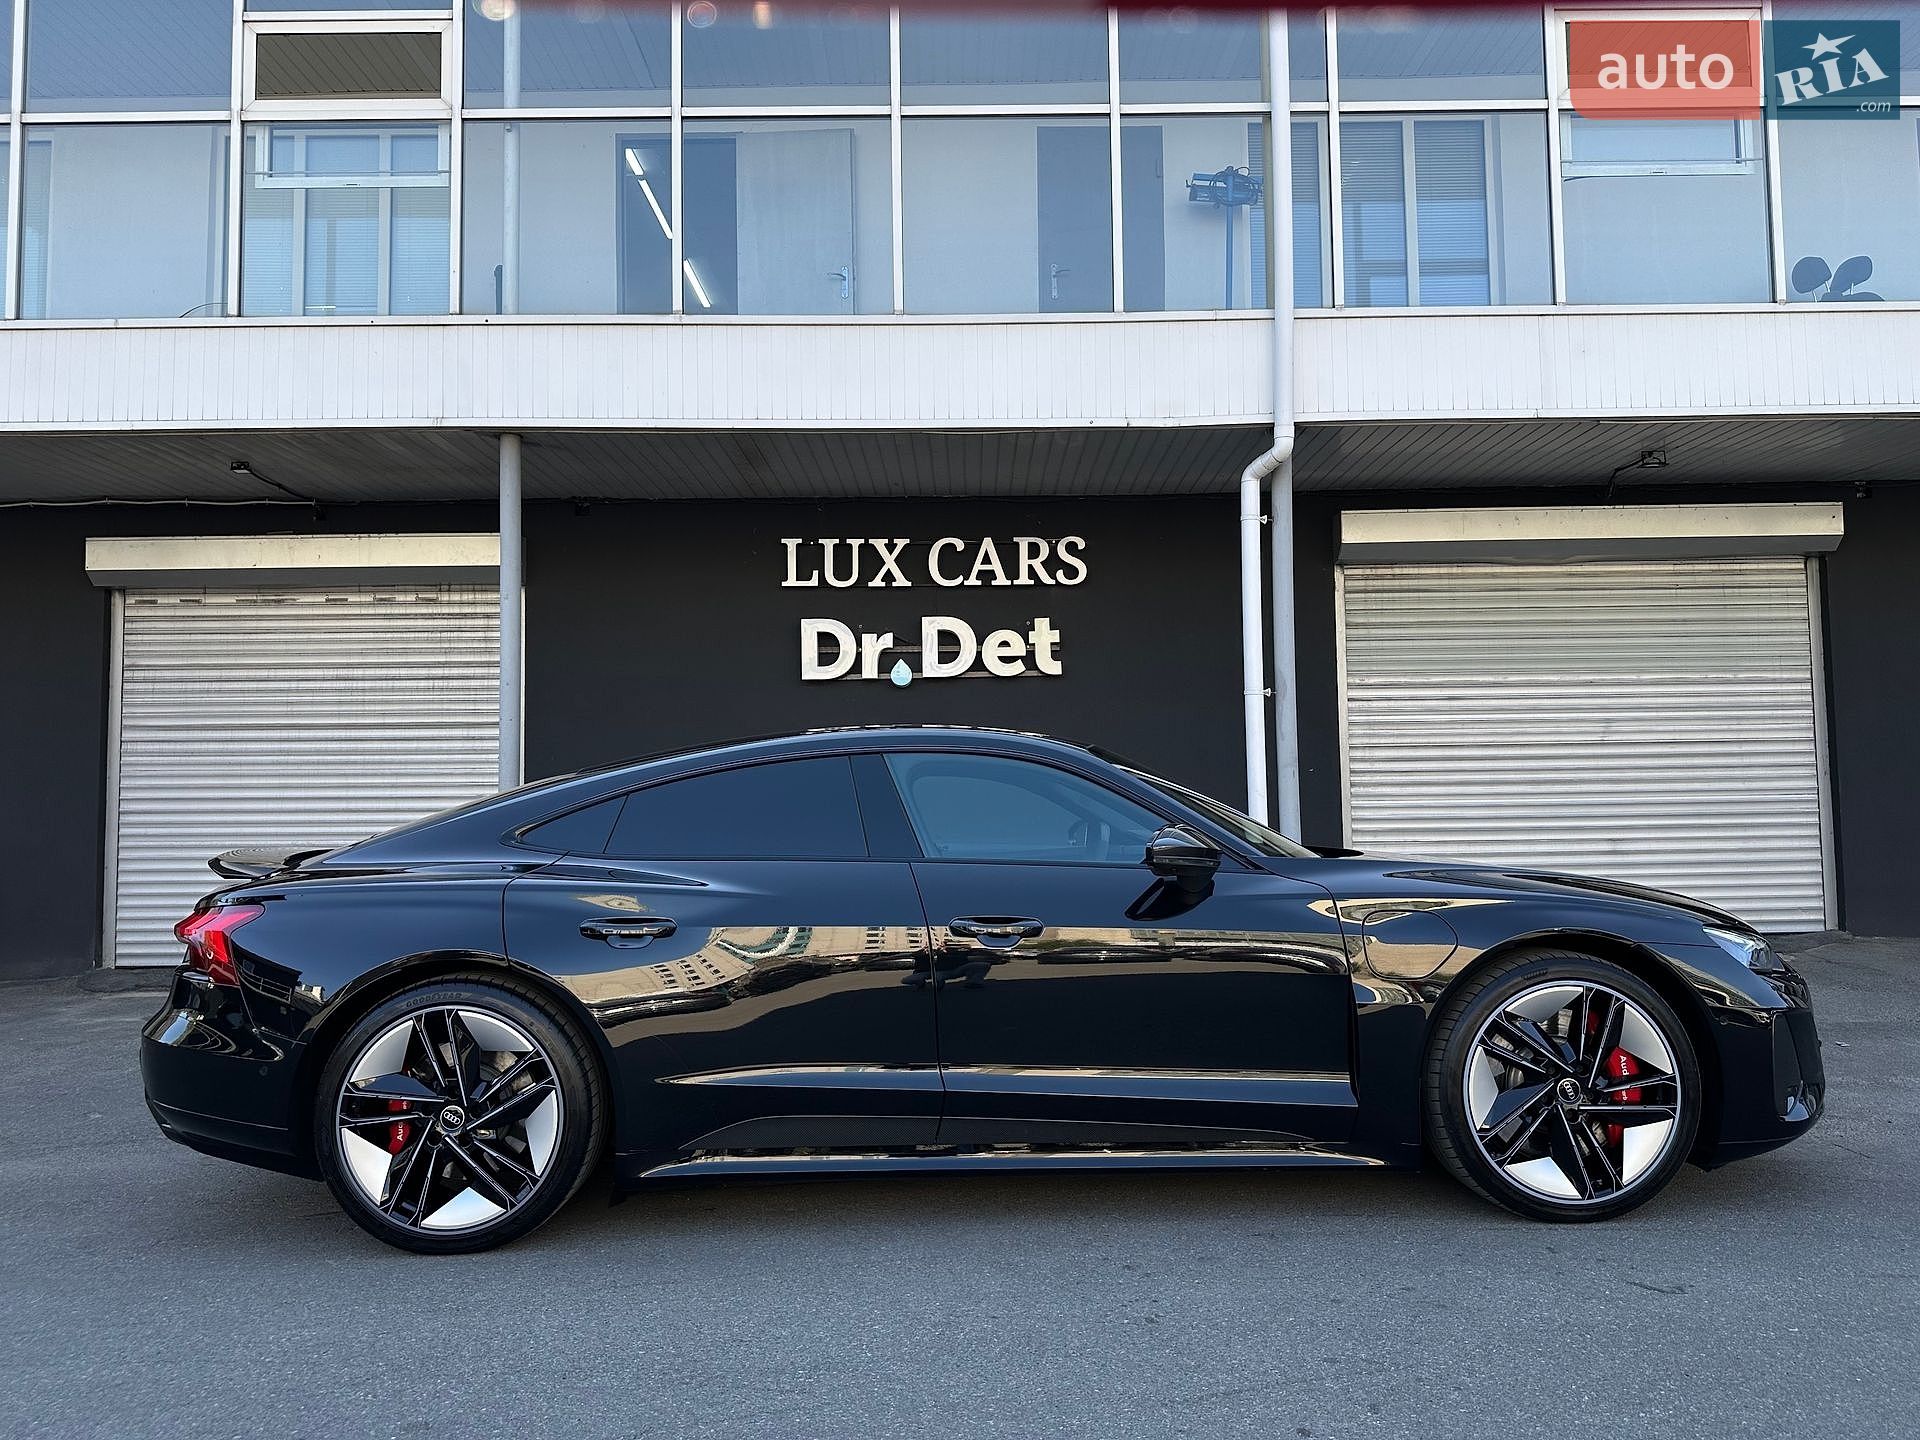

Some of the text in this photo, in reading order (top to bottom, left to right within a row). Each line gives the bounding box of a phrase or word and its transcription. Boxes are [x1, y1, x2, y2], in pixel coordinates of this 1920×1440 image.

[781, 536, 1088, 587] LUX CARS
[1620, 1055, 1630, 1077] Aud
